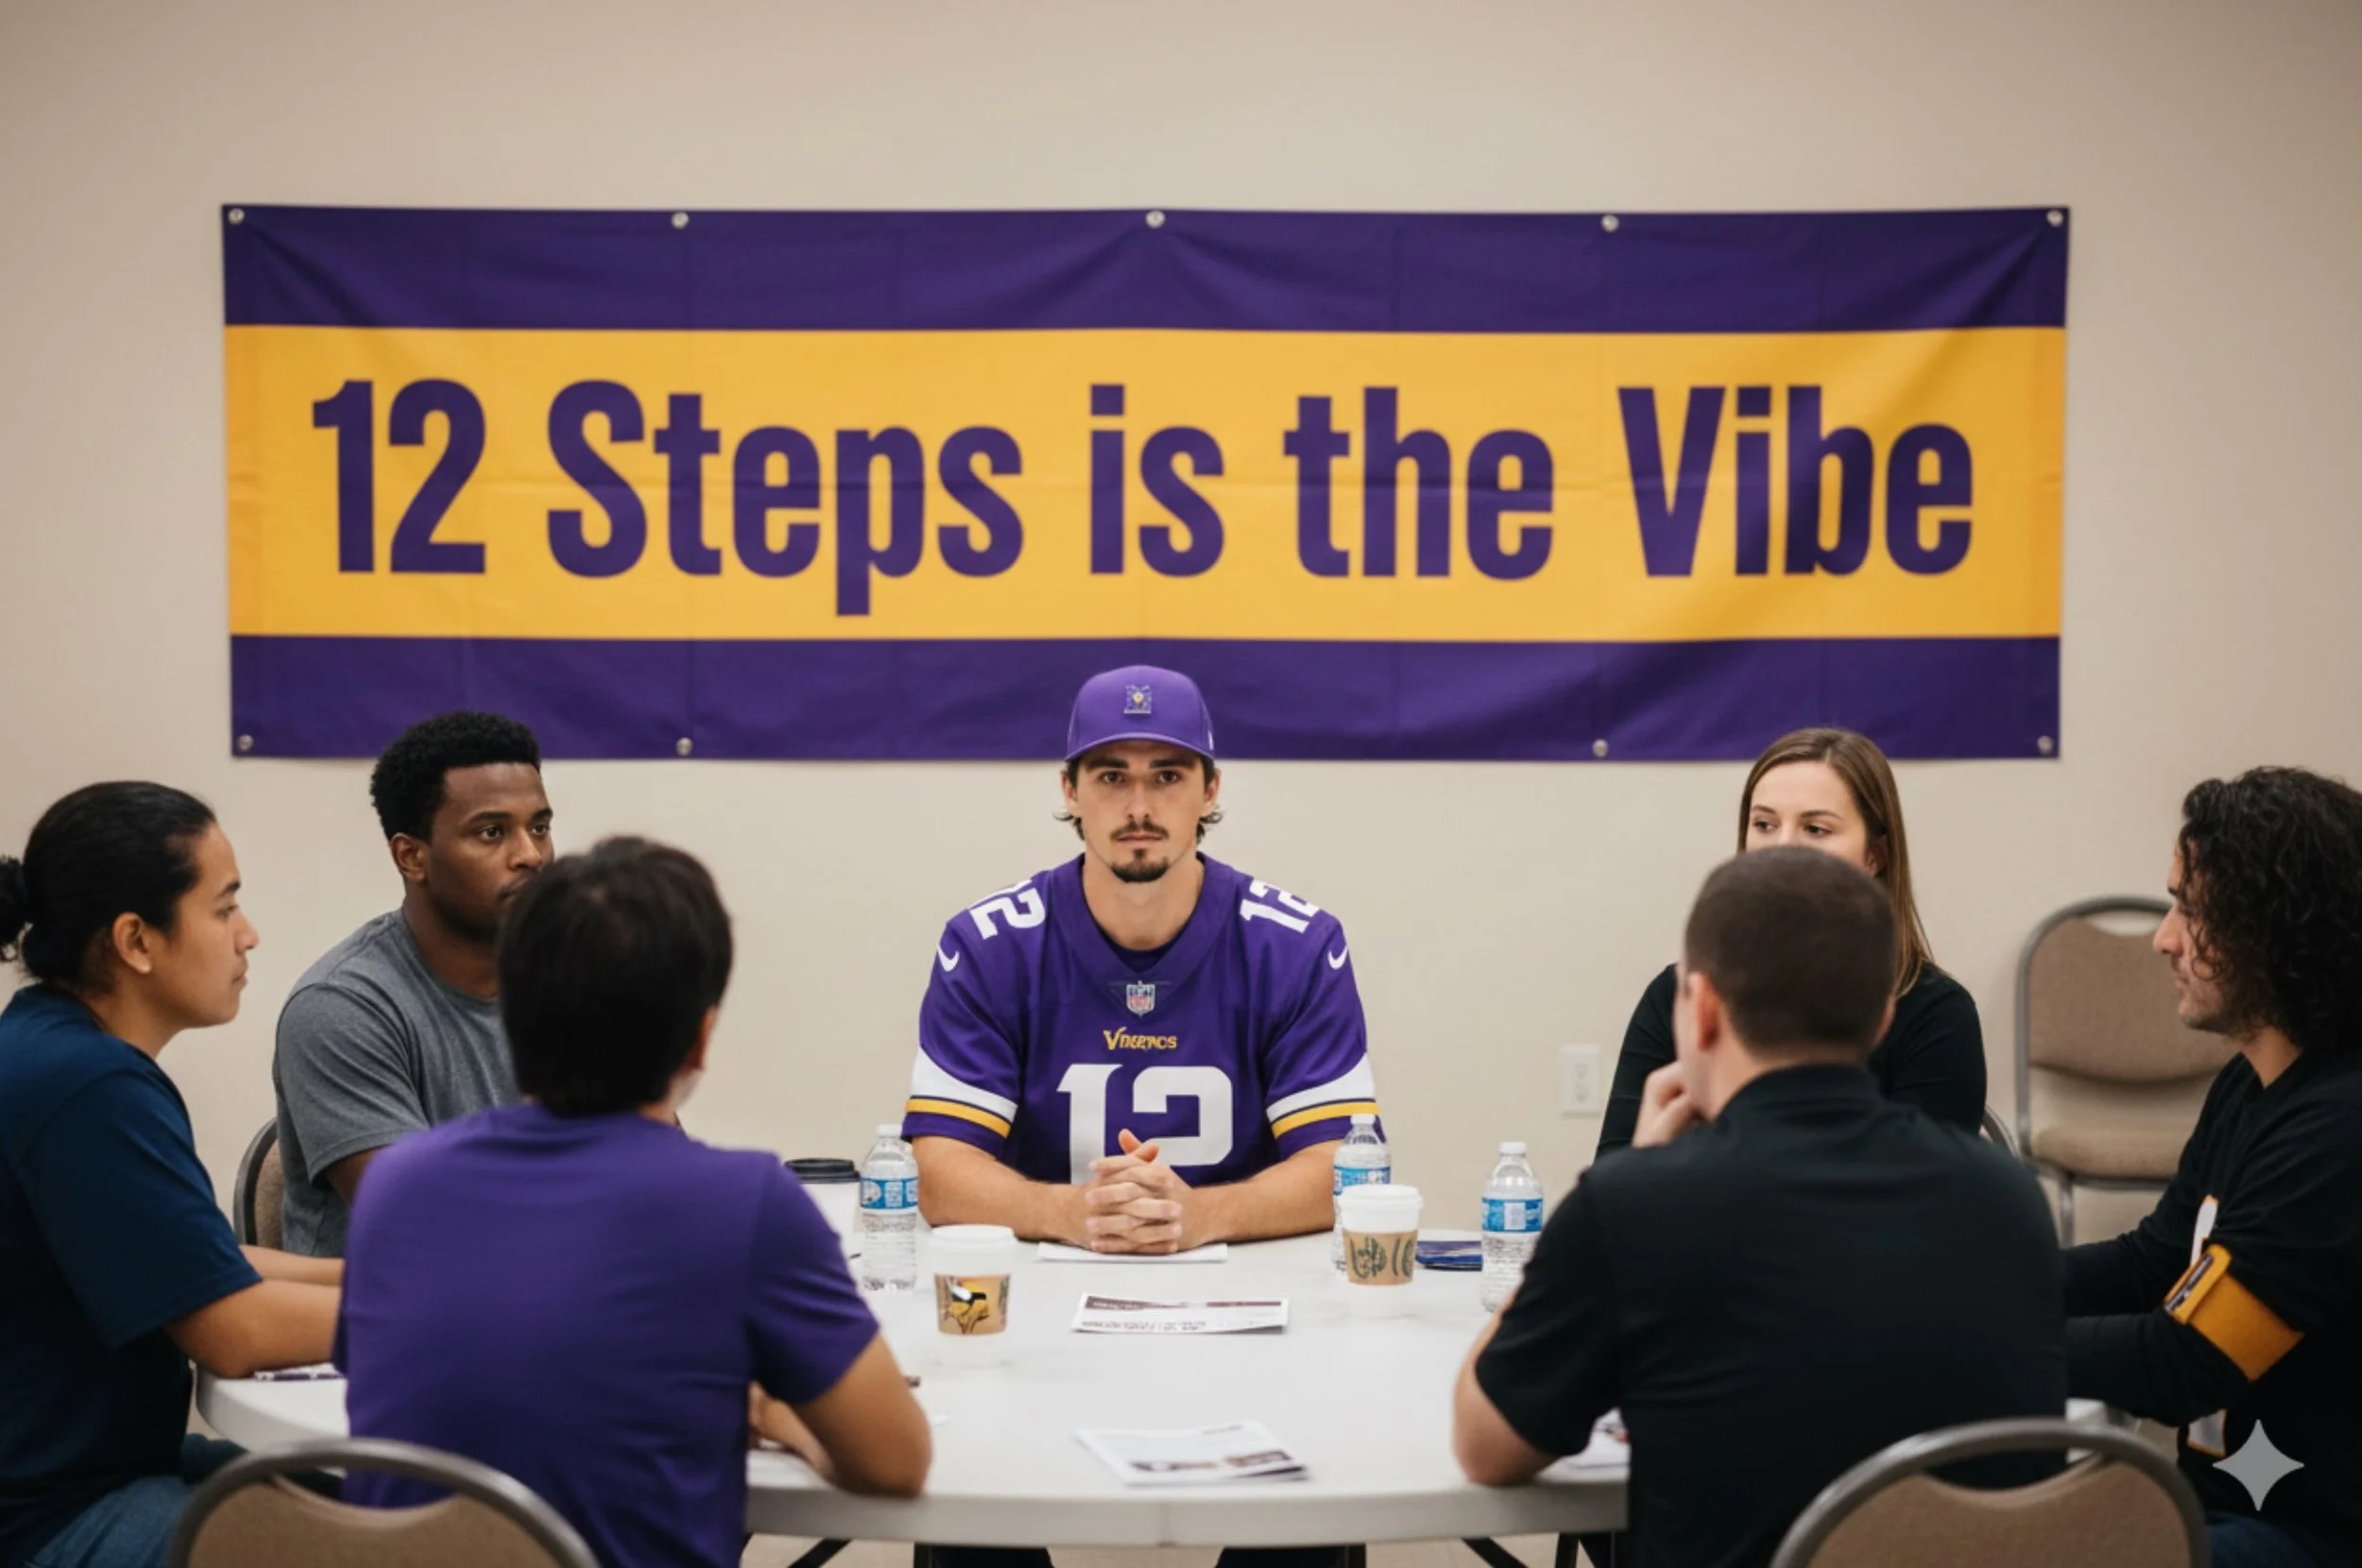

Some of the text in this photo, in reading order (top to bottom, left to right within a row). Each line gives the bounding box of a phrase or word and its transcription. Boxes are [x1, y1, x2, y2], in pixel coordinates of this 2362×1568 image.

[312, 378, 1974, 618] 12 Steps is the Vibe
[968, 879, 1046, 940] 2
[1057, 1064, 1234, 1185] 12
